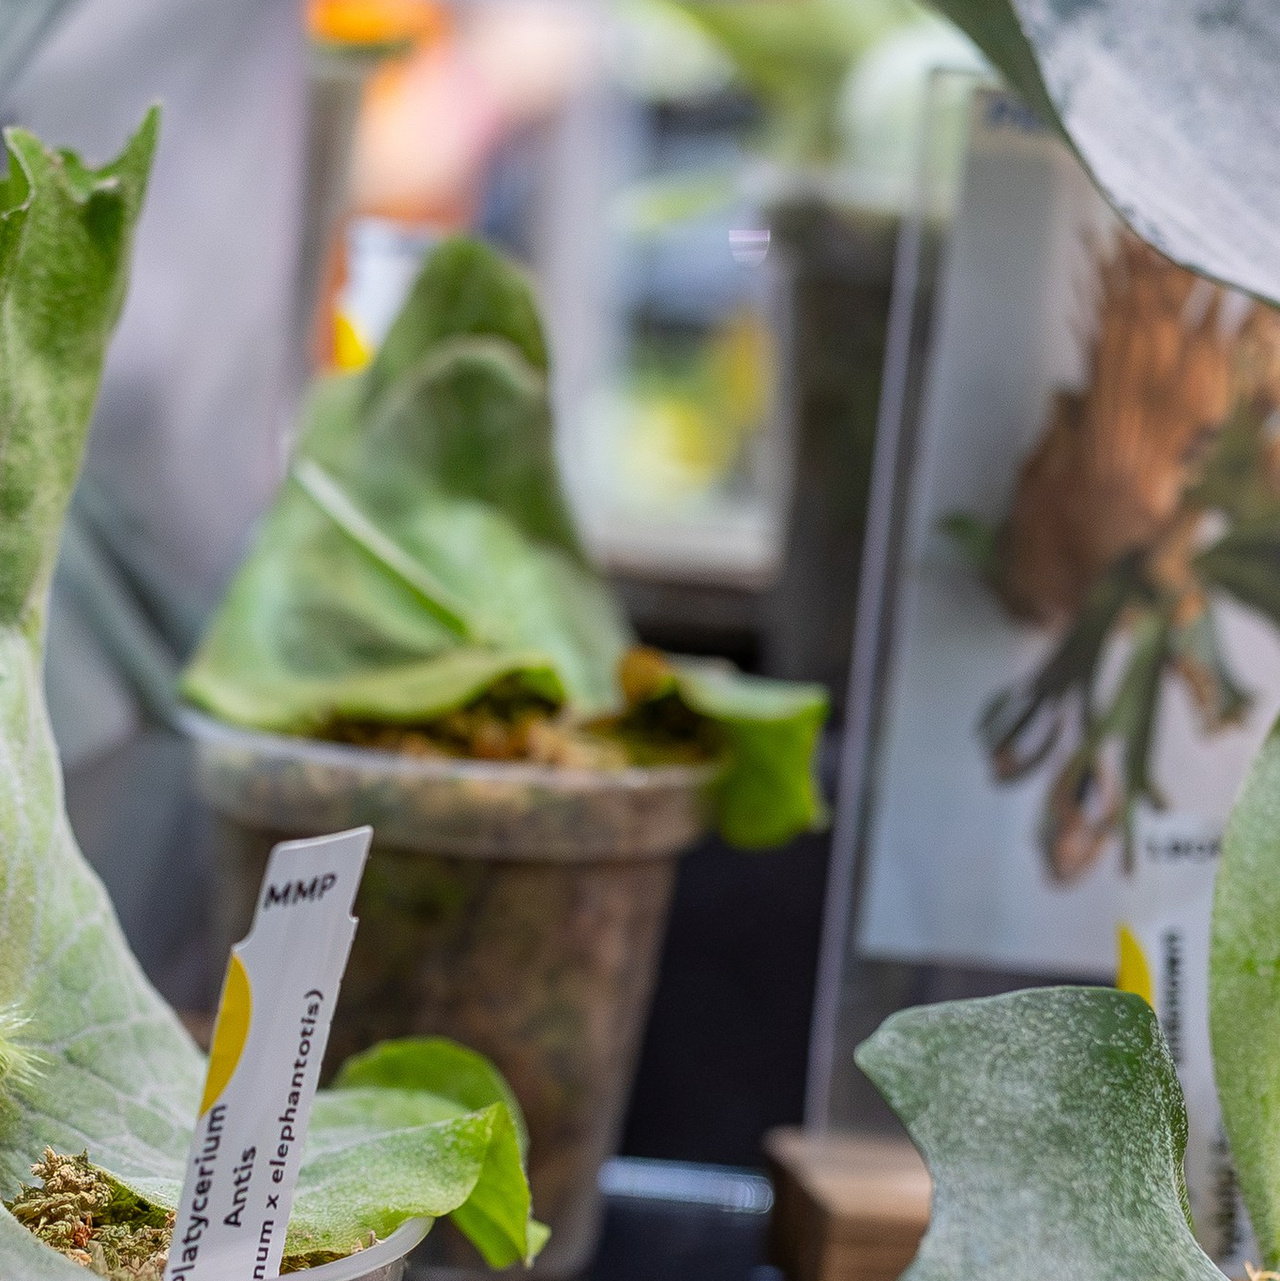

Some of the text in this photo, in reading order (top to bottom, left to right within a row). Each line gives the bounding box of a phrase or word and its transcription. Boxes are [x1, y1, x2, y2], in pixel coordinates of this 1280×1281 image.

[263, 873, 337, 910] MMP
[270, 989, 324, 1185] elephantotis)
[224, 1146, 258, 1228] Antis
[265, 1194, 280, 1210] x
